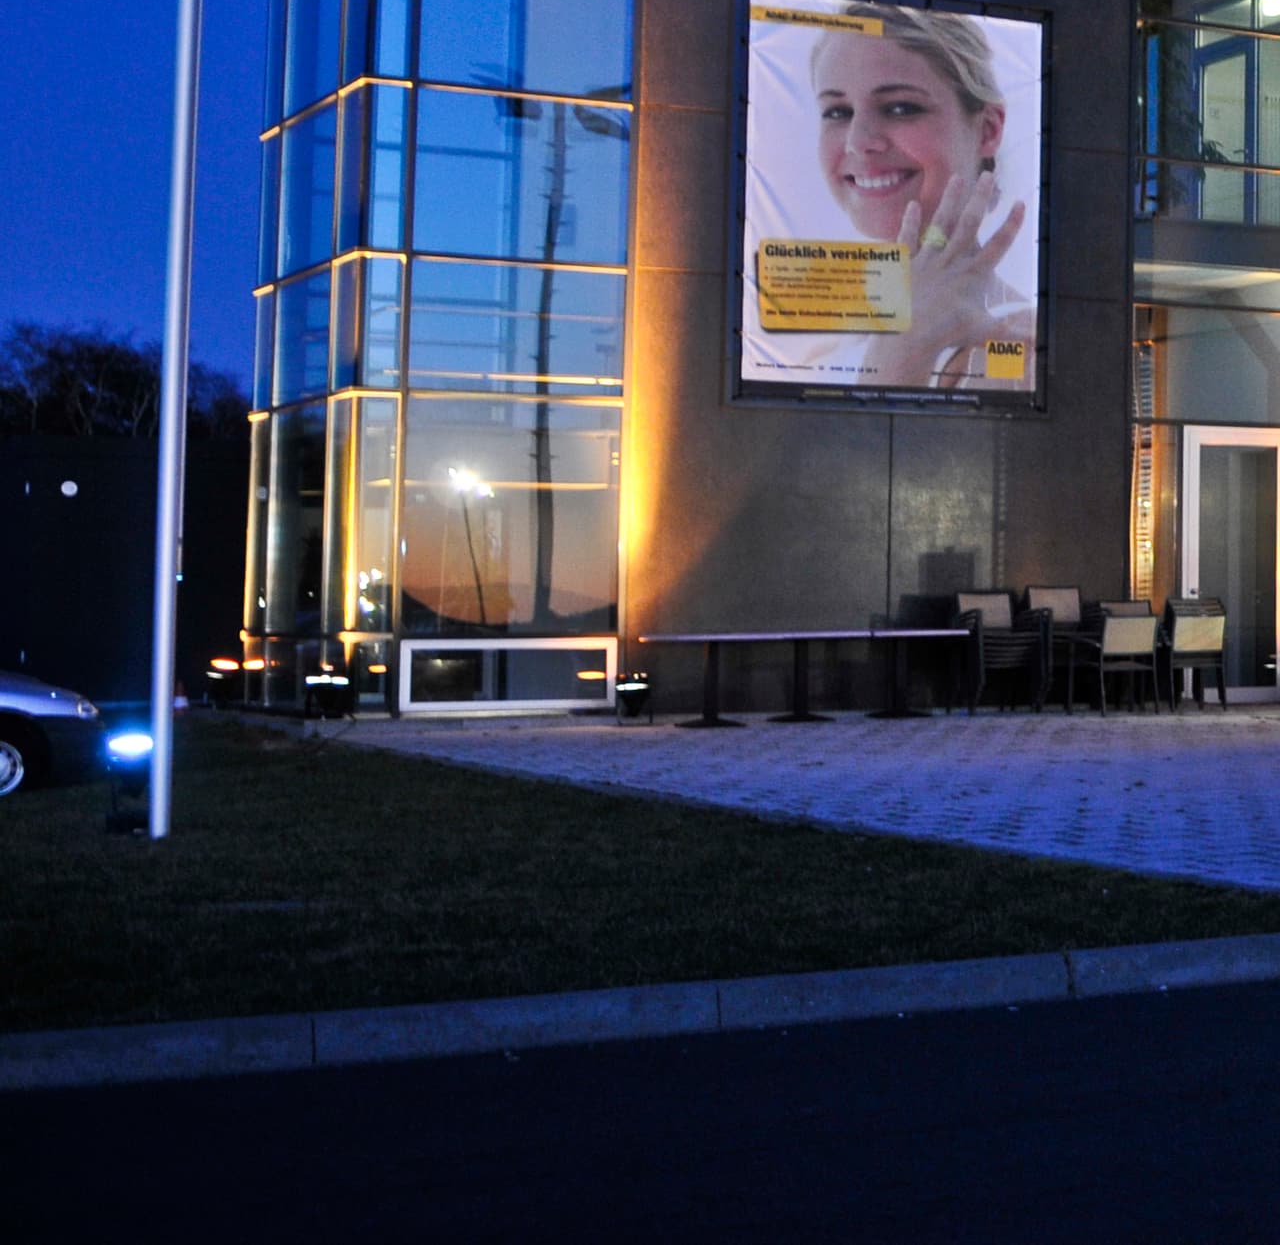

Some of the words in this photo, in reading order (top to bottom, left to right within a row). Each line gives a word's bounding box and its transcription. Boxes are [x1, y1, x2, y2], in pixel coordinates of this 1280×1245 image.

[765, 243, 827, 259] Glücklich
[830, 248, 901, 262] versichert!
[988, 342, 1023, 355] ADAC
